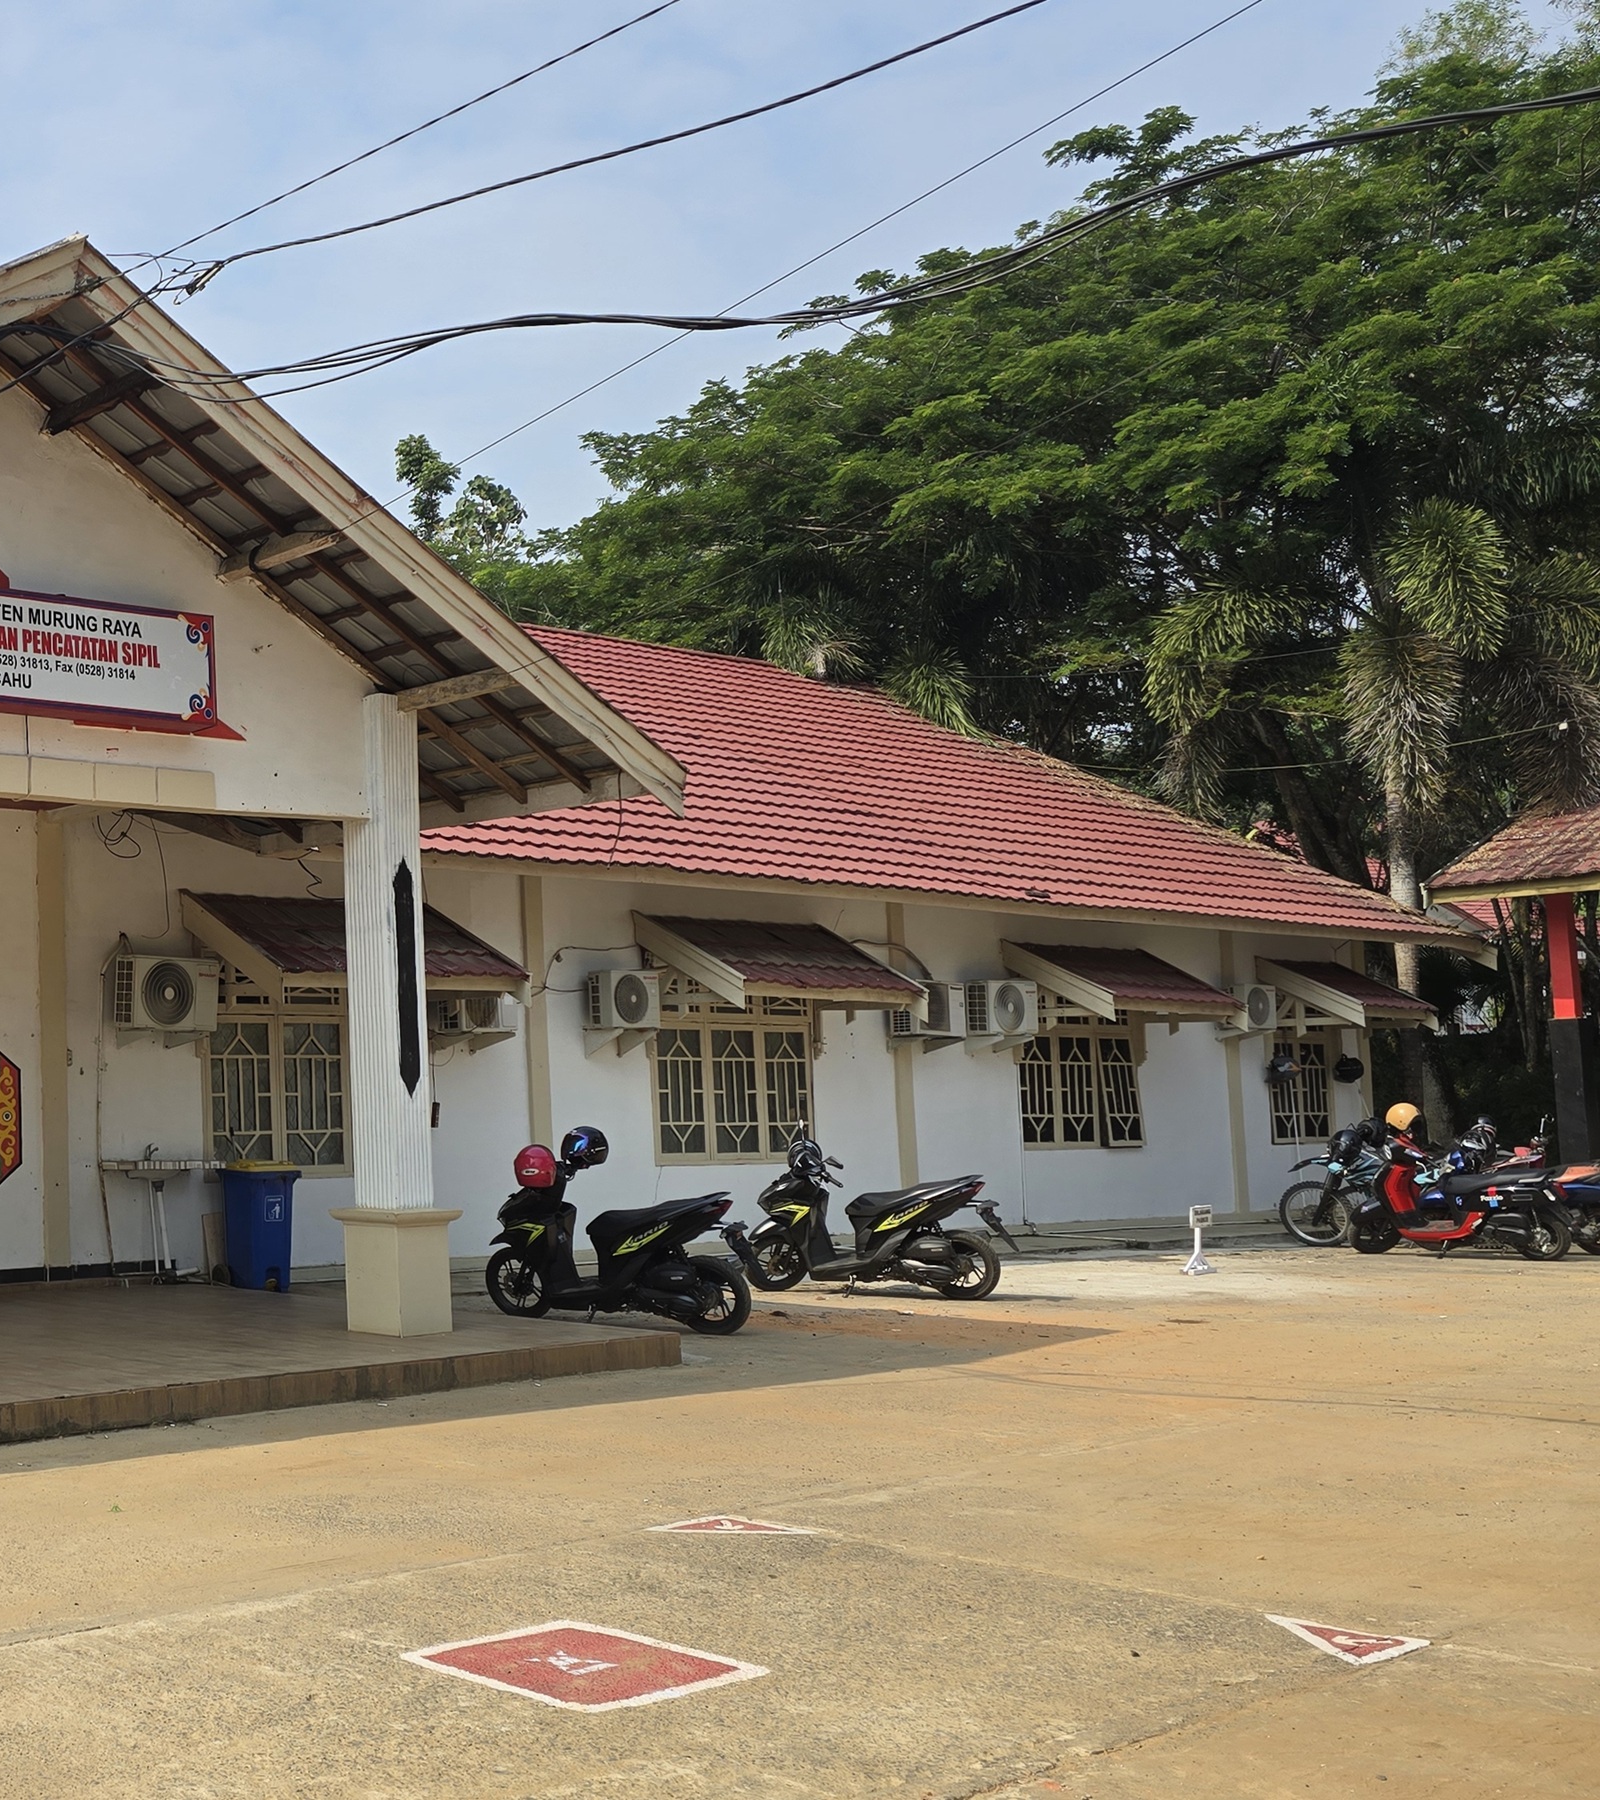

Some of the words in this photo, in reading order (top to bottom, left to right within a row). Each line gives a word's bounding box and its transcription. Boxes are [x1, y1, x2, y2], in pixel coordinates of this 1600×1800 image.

[28, 607, 98, 632] MURUNG
[102, 617, 143, 638] RAYA
[22, 628, 119, 663] PENCATATAN
[122, 641, 161, 669] SIPIL
[20, 656, 53, 673] 31813,
[55, 660, 73, 674] Fax
[75, 662, 105, 680] (0528)
[107, 667, 135, 680] 31814
